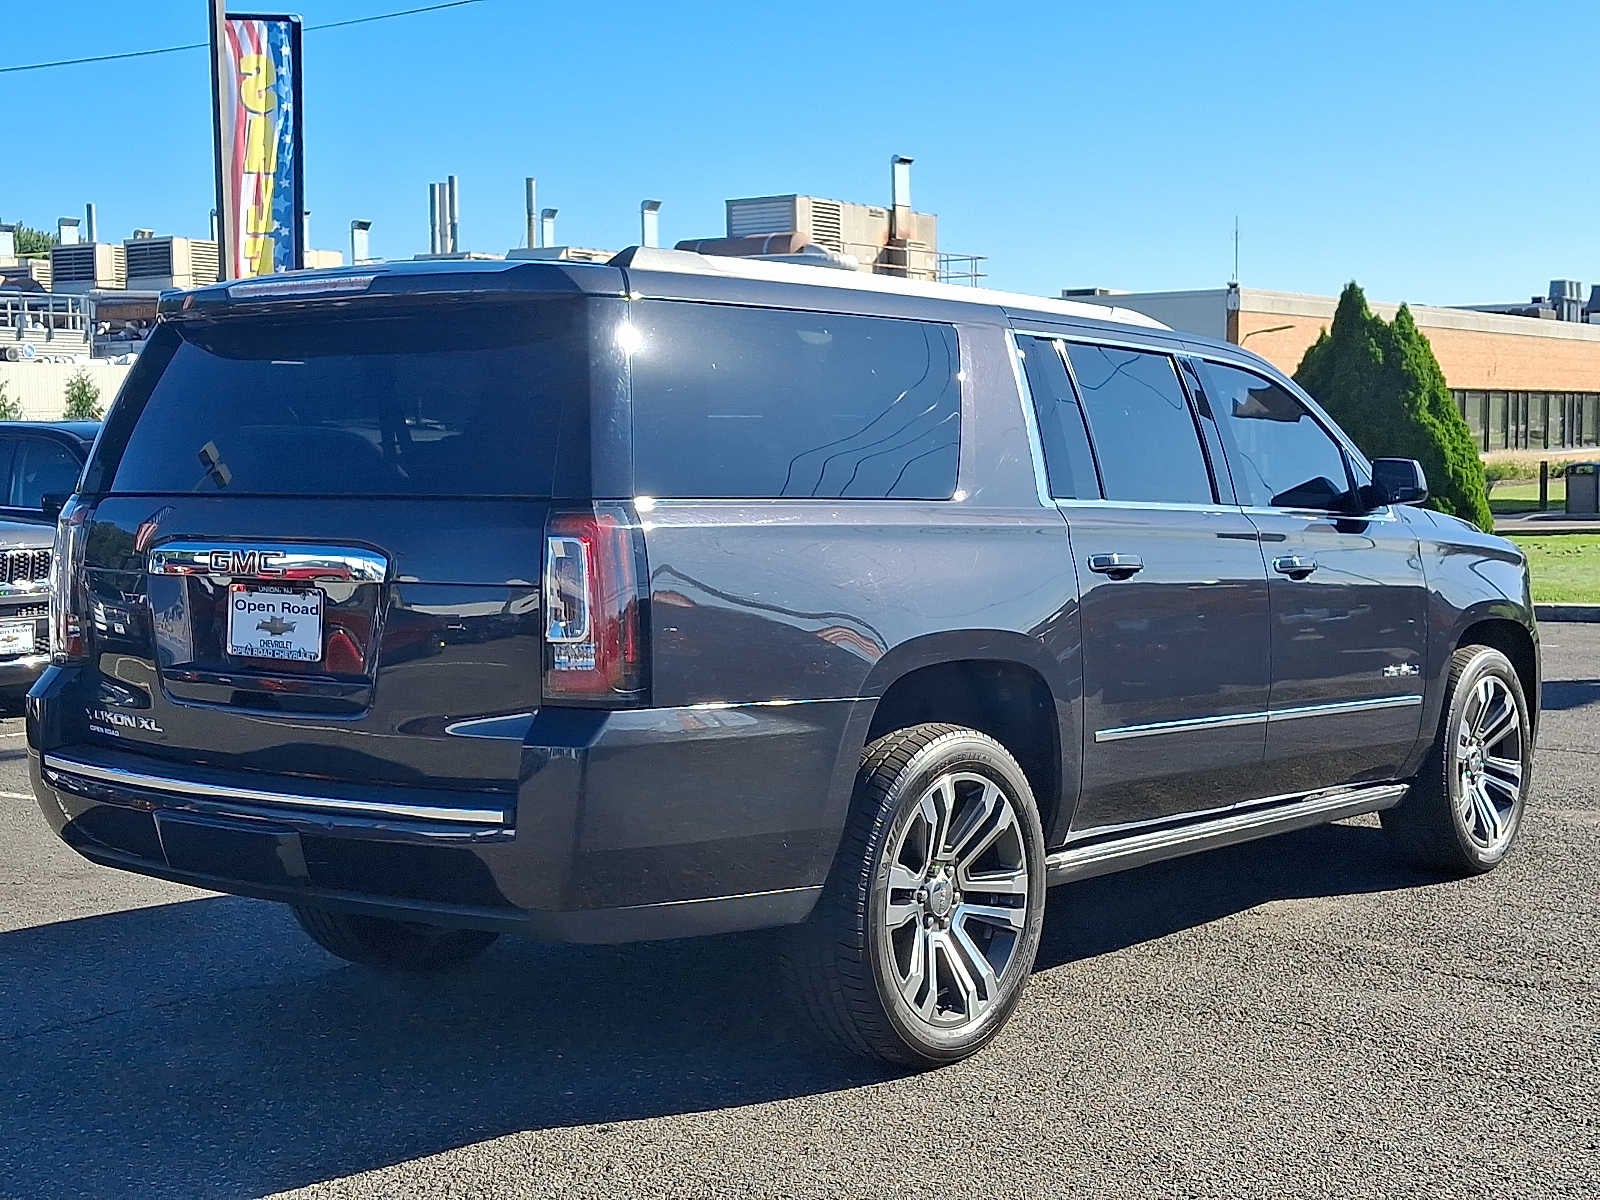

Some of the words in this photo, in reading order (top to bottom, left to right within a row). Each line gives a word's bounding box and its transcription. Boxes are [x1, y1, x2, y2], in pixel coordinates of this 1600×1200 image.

[208, 549, 286, 576] GMC
[235, 599, 276, 614] Open
[281, 602, 319, 616] Road
[232, 646, 252, 656] OPEN
[254, 647, 274, 657] ROAD
[260, 639, 292, 649] CHEVROLET
[85, 707, 136, 728] YUKON
[138, 716, 163, 732] XL
